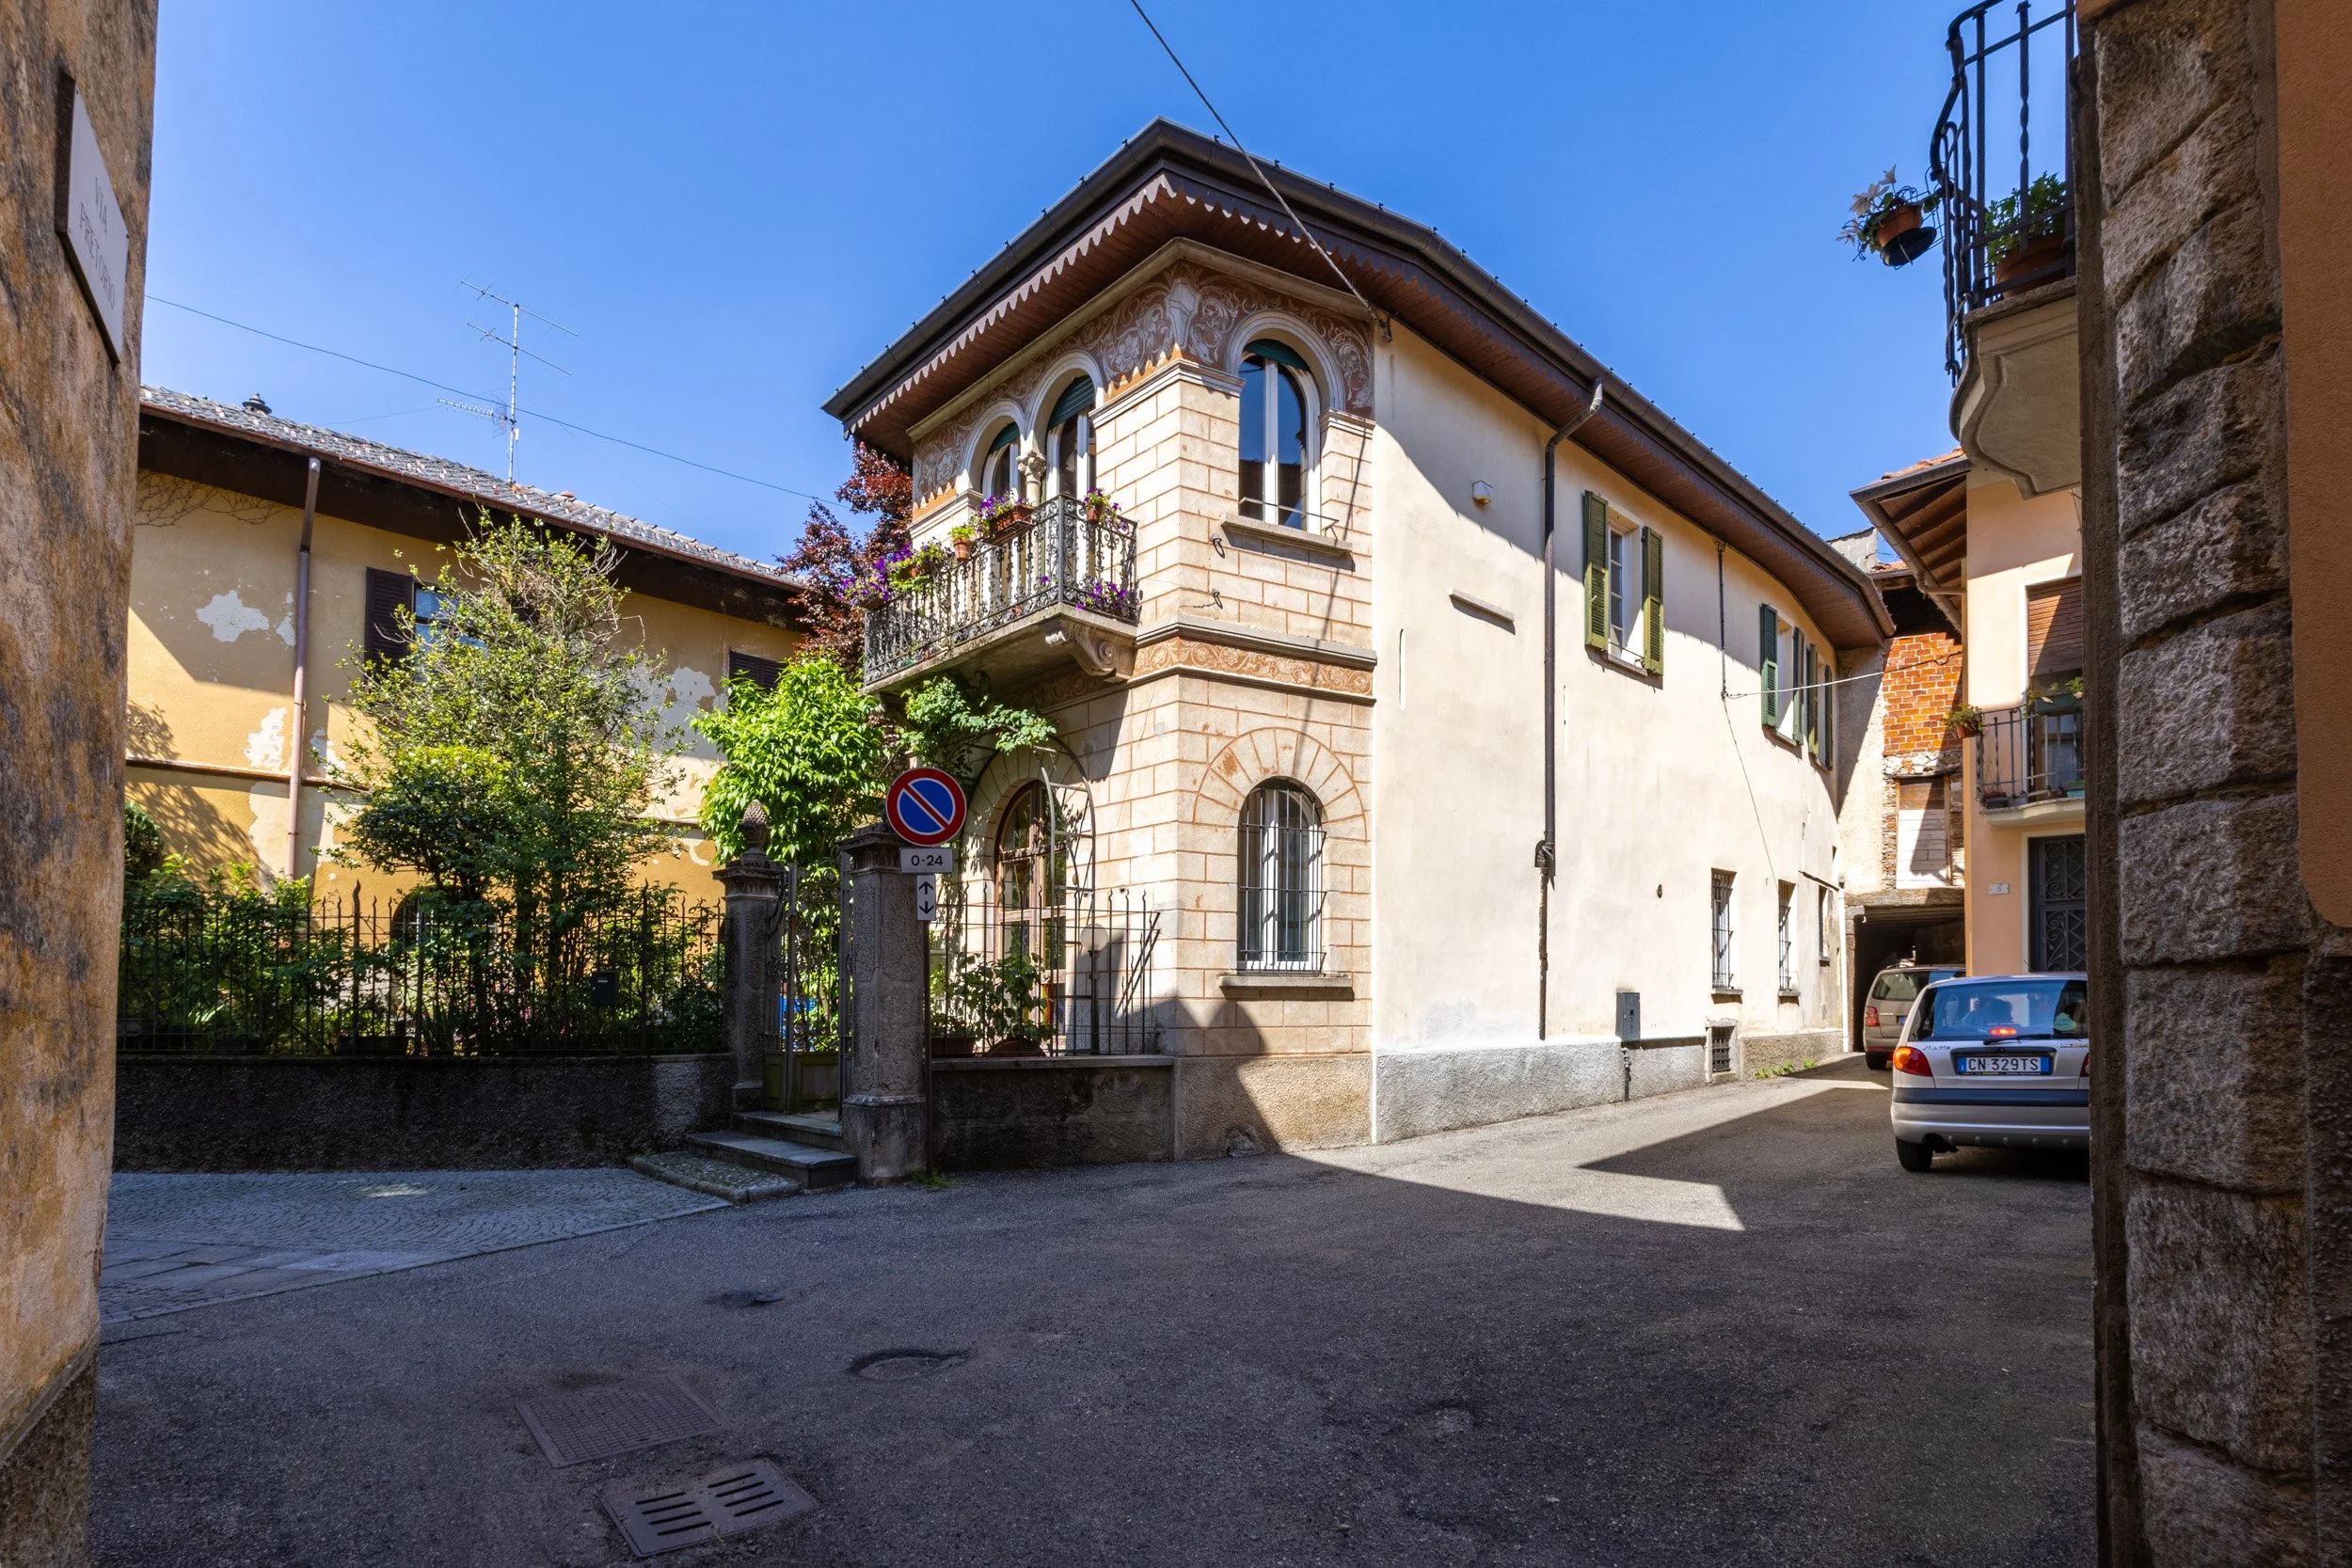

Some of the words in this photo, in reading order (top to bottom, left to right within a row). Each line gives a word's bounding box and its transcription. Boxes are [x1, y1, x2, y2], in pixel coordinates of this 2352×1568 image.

[95, 175, 107, 234] VIA
[79, 201, 115, 310] PRETORIO
[911, 854, 944, 866] 0-24
[1968, 1058, 1986, 1070] CN
[1991, 1058, 2039, 1071] 329TS
